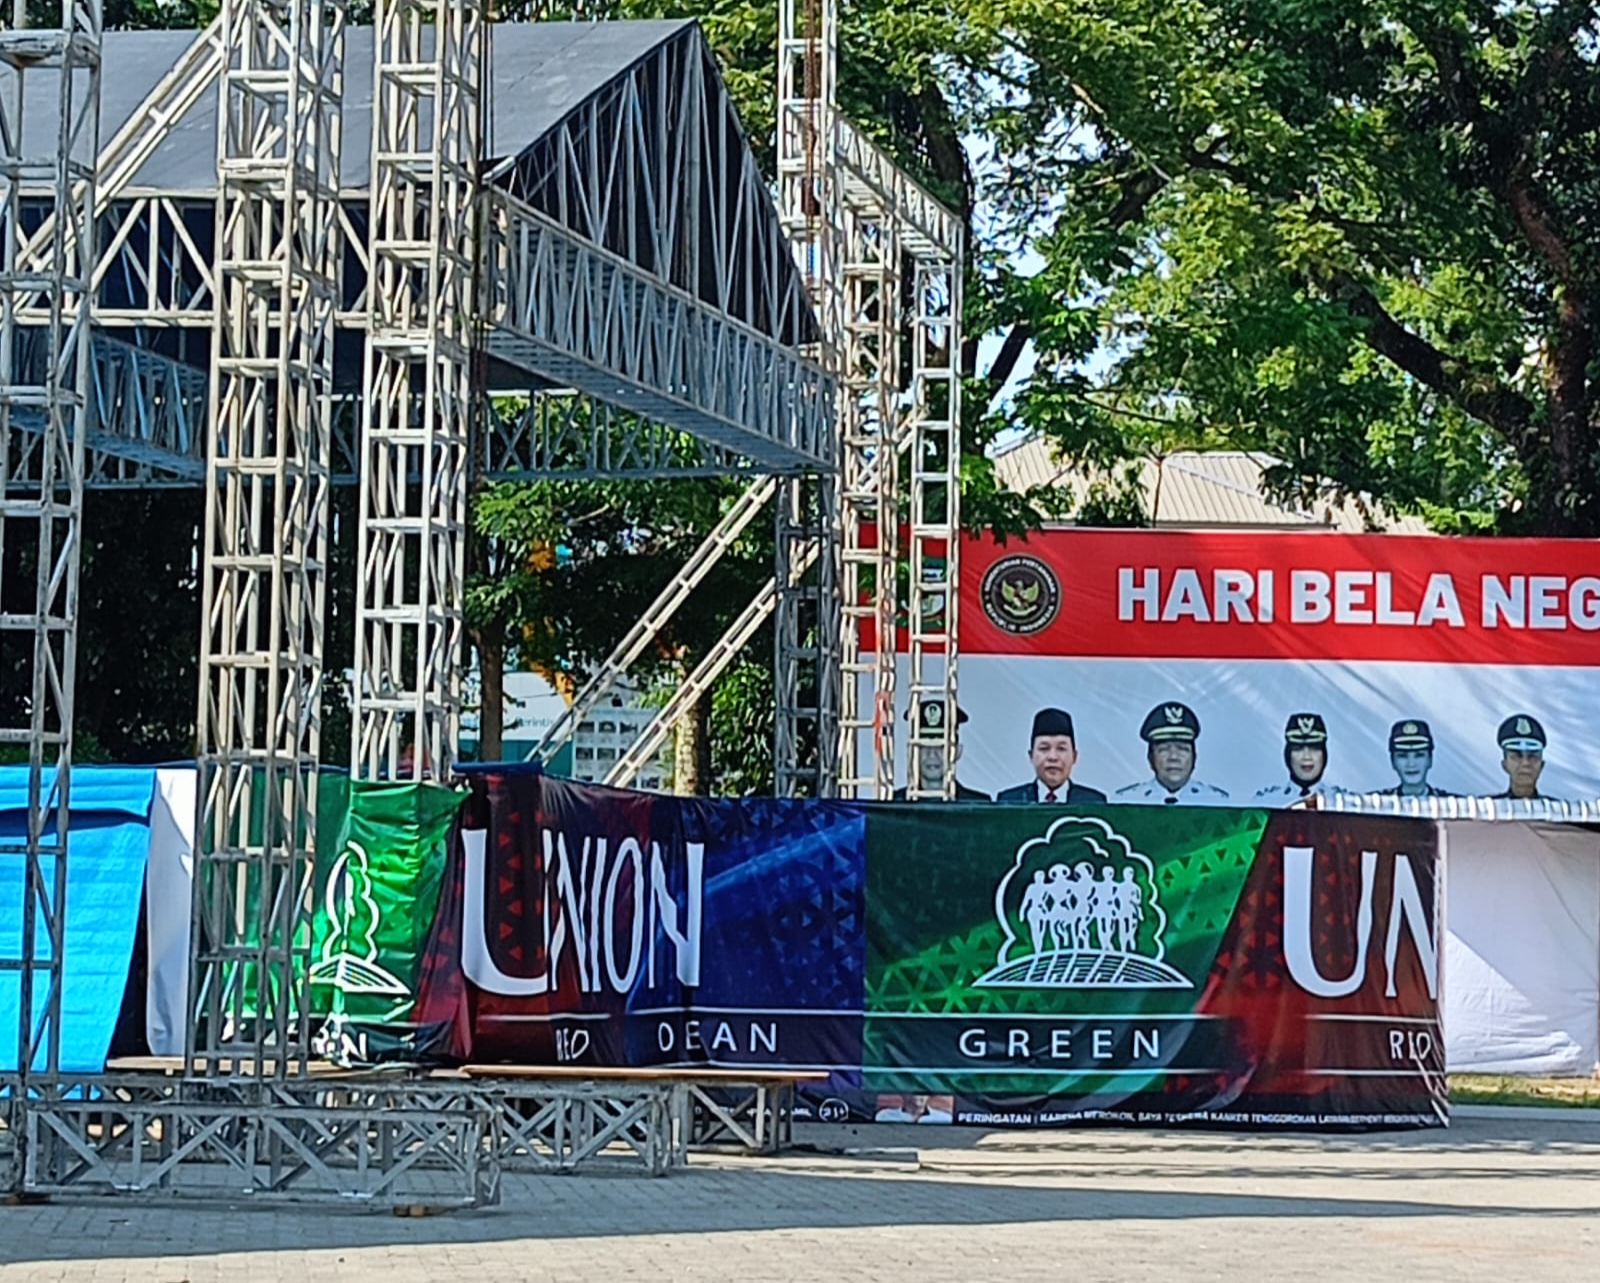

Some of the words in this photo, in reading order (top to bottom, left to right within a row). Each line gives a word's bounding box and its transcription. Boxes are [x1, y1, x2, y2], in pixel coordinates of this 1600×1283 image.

[1117, 568, 1273, 623] HARI
[1290, 569, 1466, 627] BELA
[1481, 574, 1600, 631] NEG
[461, 828, 704, 995] UNION
[959, 1029, 1159, 1058] GREEN
[958, 1112, 1031, 1124] PERINGATAN
